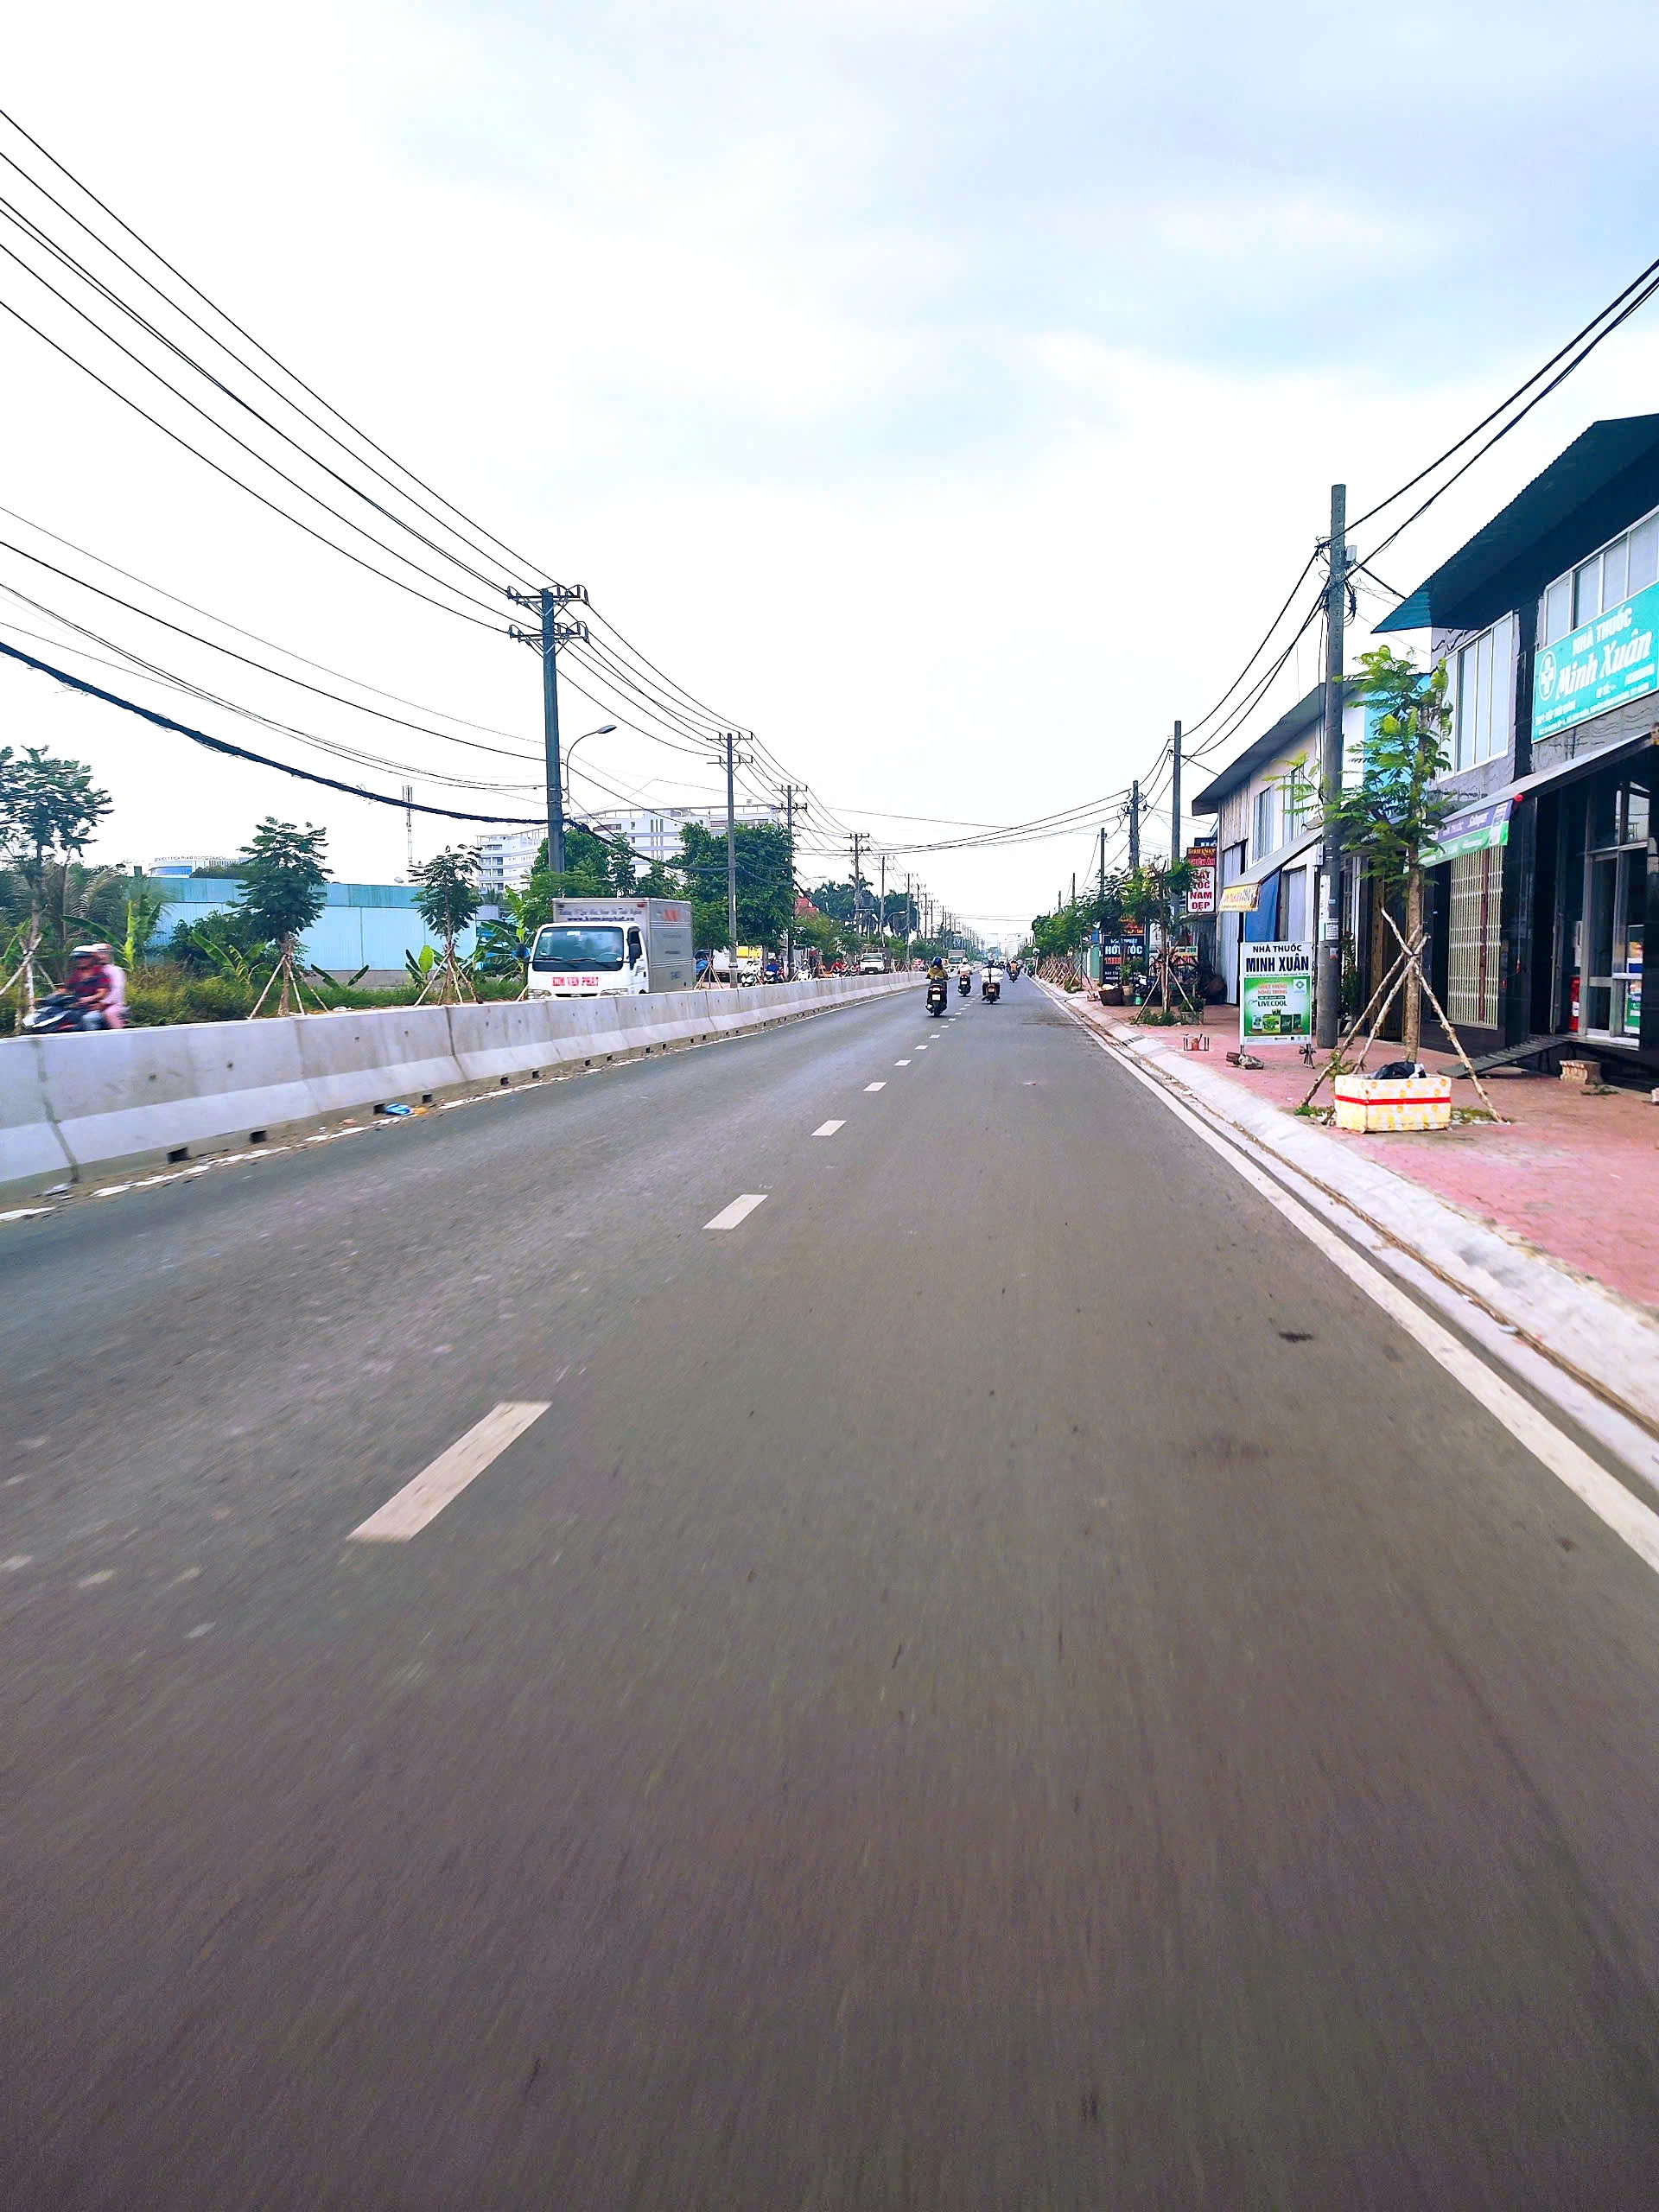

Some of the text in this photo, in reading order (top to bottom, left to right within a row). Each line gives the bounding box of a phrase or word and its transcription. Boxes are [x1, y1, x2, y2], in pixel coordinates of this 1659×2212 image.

[1556, 652, 1598, 701] Minh
[1599, 628, 1652, 680] Xuân
[1190, 891, 1212, 899] NAM
[1252, 942, 1302, 953] NHÀ THUỐC
[1245, 952, 1309, 973] MINH XUÂN
